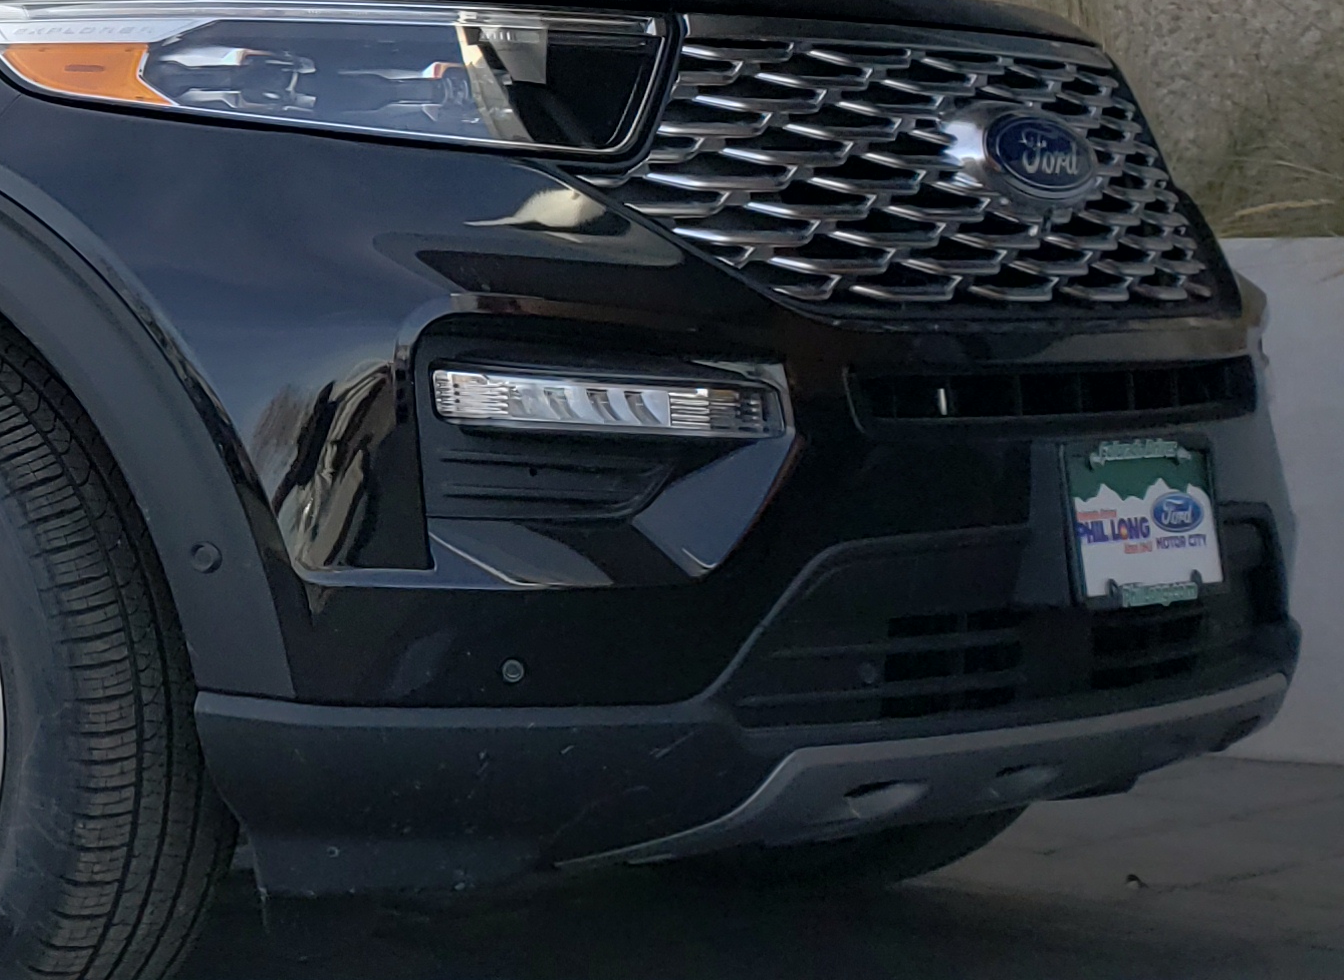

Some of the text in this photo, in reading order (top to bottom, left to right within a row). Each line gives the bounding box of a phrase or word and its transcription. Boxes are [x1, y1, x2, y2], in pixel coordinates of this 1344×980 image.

[1018, 125, 1079, 176] Ford
[1162, 498, 1193, 526] Ford
[1111, 516, 1151, 541] LONG
[1155, 535, 1187, 550] MOTOR
[1187, 533, 1208, 548] CITY
